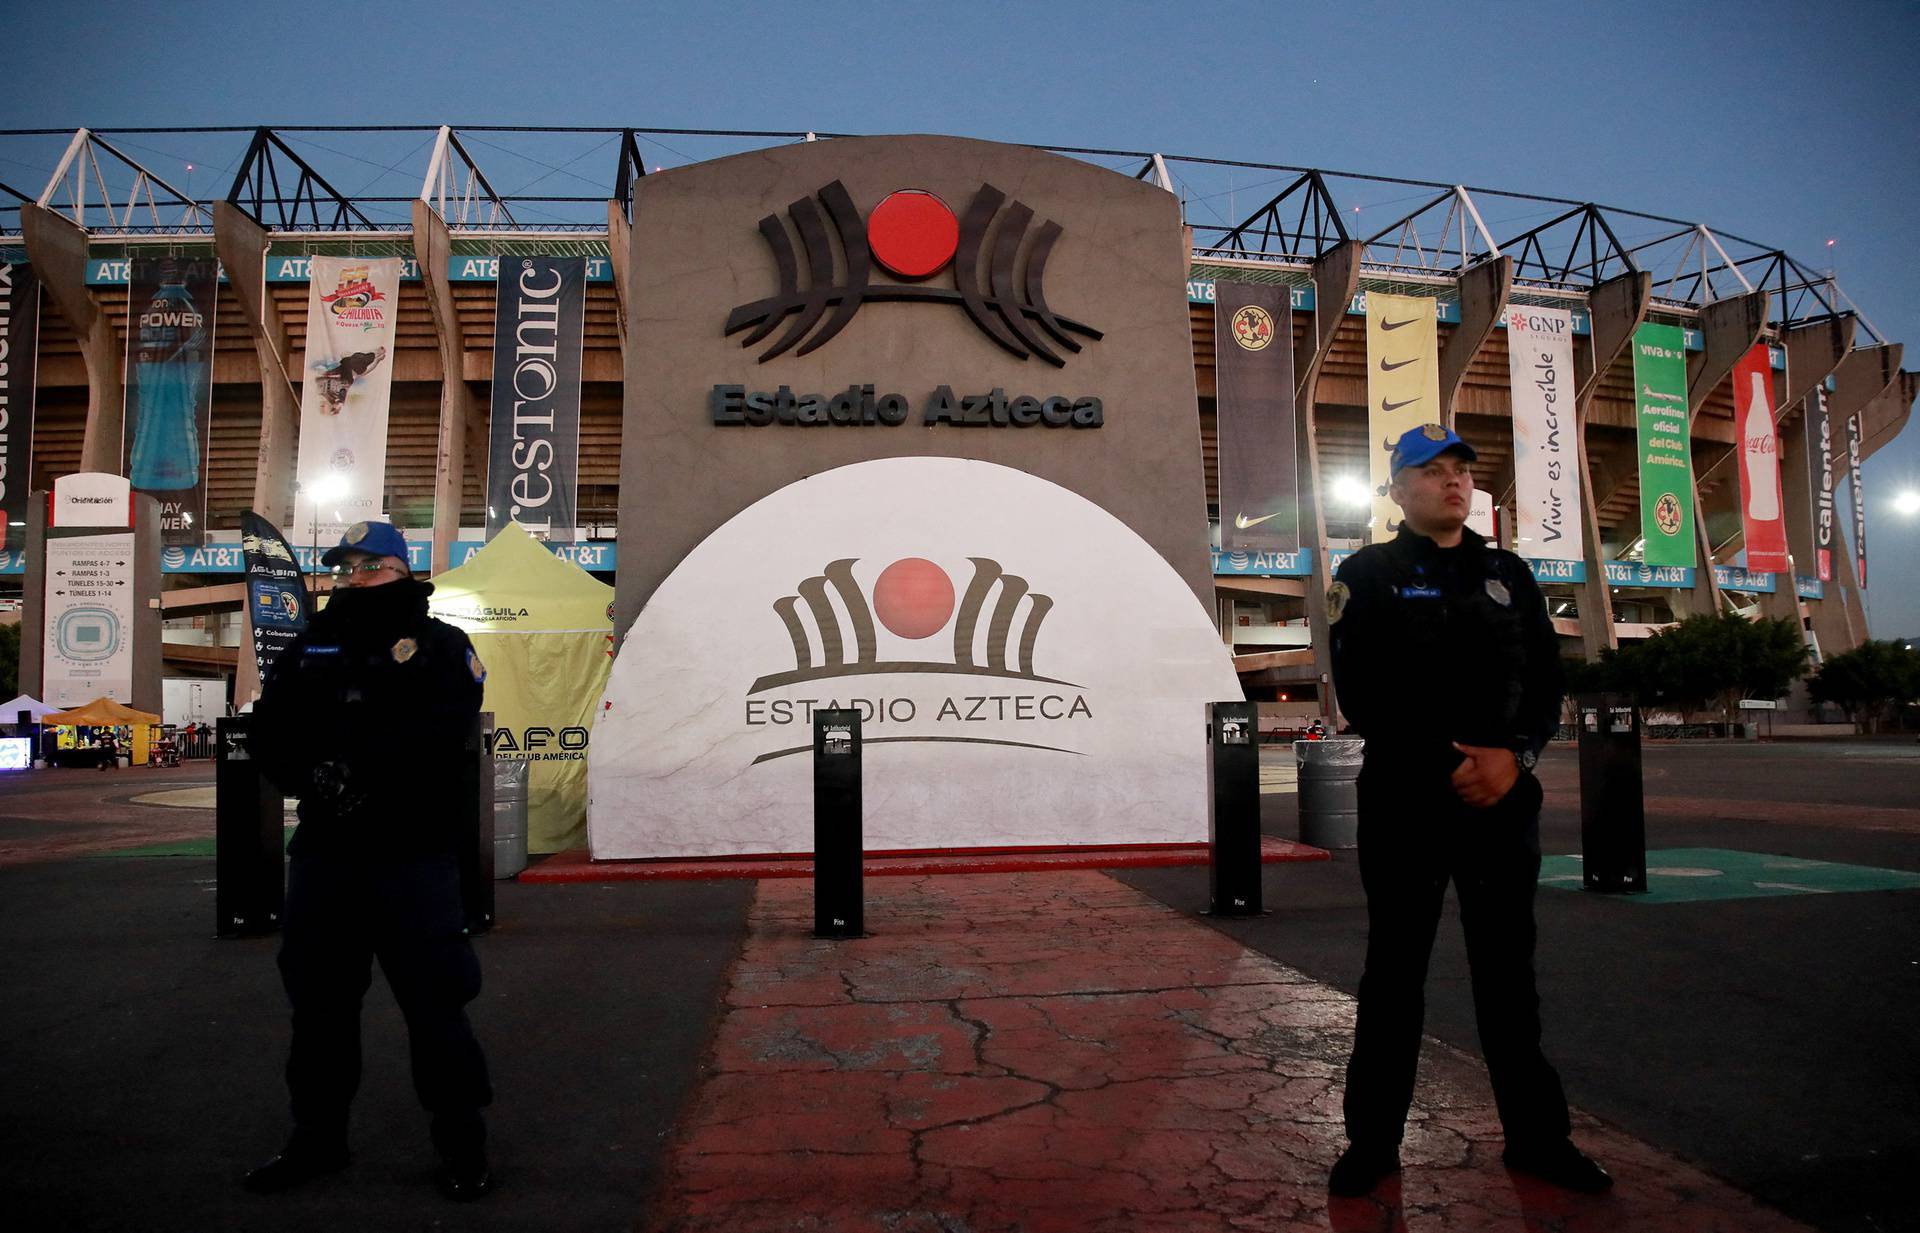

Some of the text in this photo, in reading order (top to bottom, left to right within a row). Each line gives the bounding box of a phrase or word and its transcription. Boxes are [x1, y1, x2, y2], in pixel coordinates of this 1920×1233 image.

[1529, 315, 1565, 333] GNP
[712, 383, 1105, 428] Estadio Azteca
[1535, 352, 1562, 542] Vivir es increíble
[190, 548, 243, 567] AT&T
[1253, 552, 1299, 569] AT&T
[1538, 560, 1576, 577] AT&T
[1655, 566, 1687, 583] AT&T
[936, 695, 1093, 722] AZTECA
[542, 751, 585, 761] AMÉRICA
